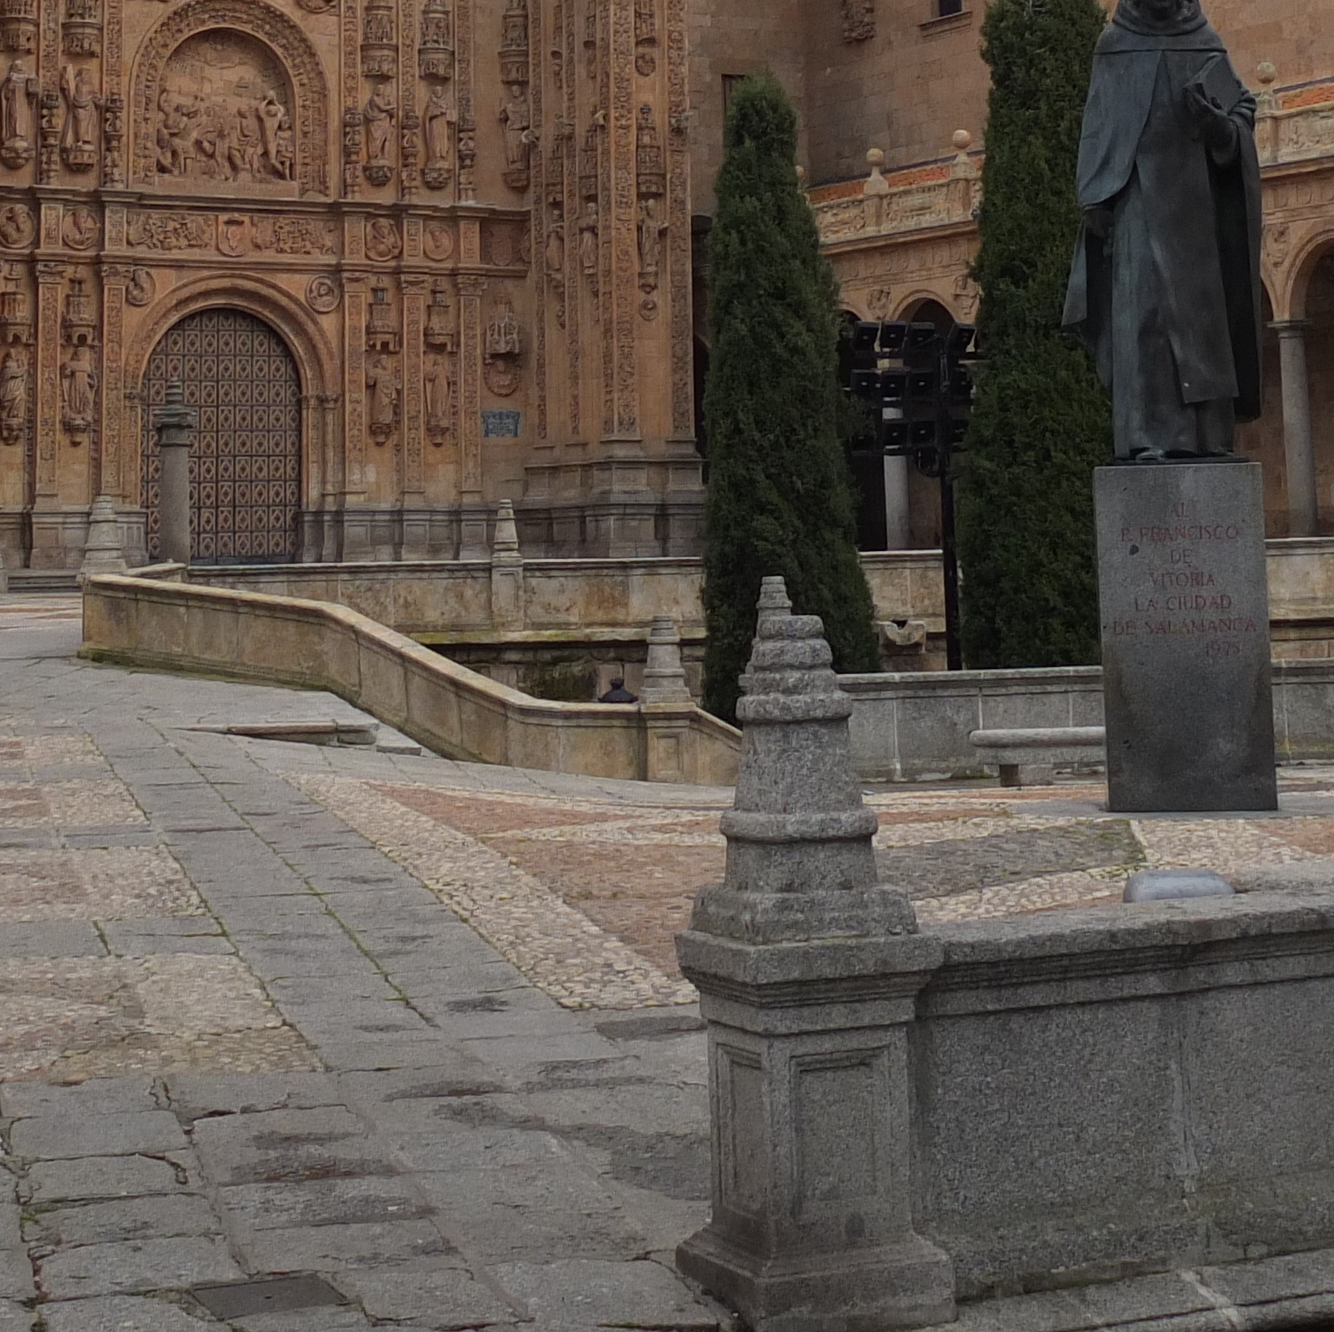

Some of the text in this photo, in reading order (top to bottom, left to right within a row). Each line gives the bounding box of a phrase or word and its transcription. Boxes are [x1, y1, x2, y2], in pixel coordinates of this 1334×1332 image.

[1171, 502, 1188, 518] AL
[1139, 525, 1239, 542] FRANCISCO
[1170, 548, 1194, 564] DE
[1149, 572, 1215, 588] VITORIA
[1134, 595, 1232, 612] LA CIUDAD
[1113, 618, 1257, 635] DE SALAMANCA
